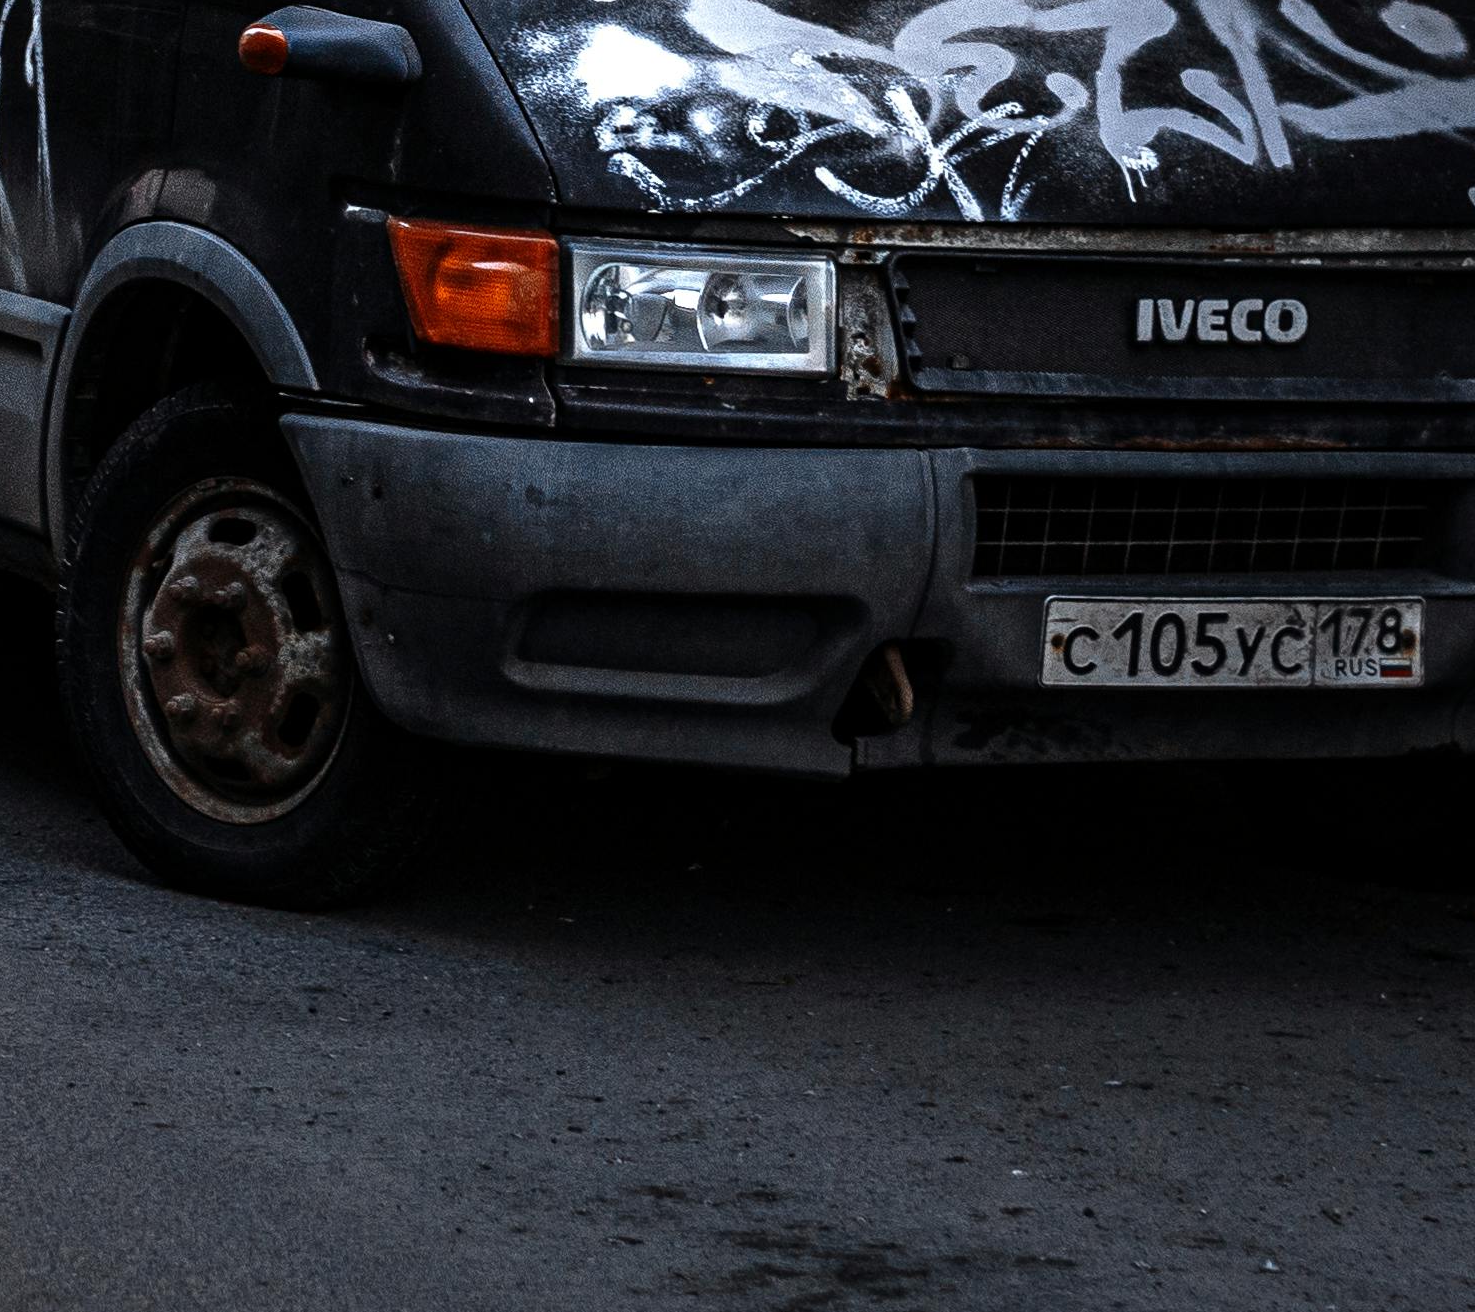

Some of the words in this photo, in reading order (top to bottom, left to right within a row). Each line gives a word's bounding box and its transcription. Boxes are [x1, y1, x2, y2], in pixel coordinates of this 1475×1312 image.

[1137, 299, 1308, 342] IVECO
[1319, 607, 1404, 657] 178
[1334, 658, 1378, 677] RUS
